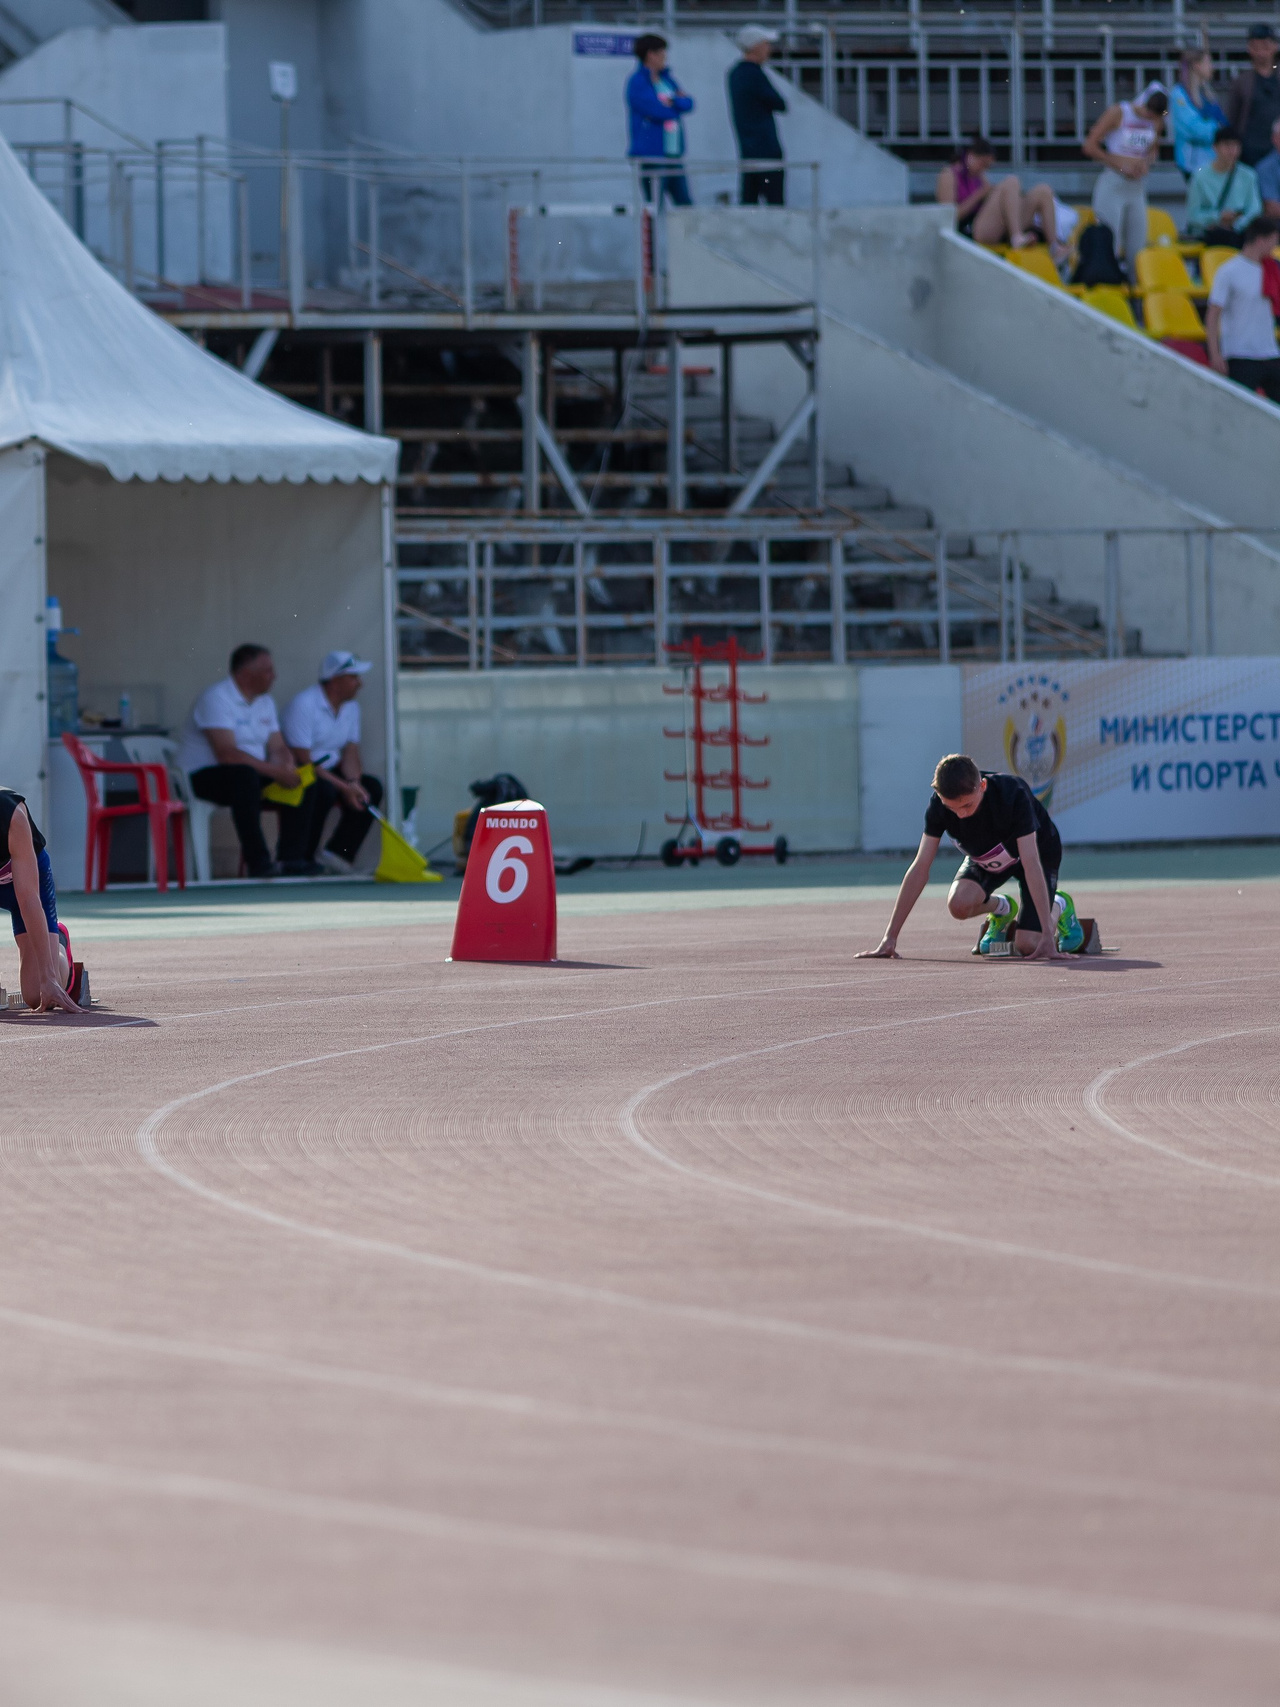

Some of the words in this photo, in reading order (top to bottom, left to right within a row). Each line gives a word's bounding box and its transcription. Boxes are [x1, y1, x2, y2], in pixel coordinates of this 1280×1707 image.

[1100, 713, 1280, 744] МИНИСТЕРСТ
[1131, 763, 1150, 792] И
[1157, 760, 1268, 791] СПОРТА
[485, 818, 538, 829] MONDO
[485, 835, 534, 904] 6
